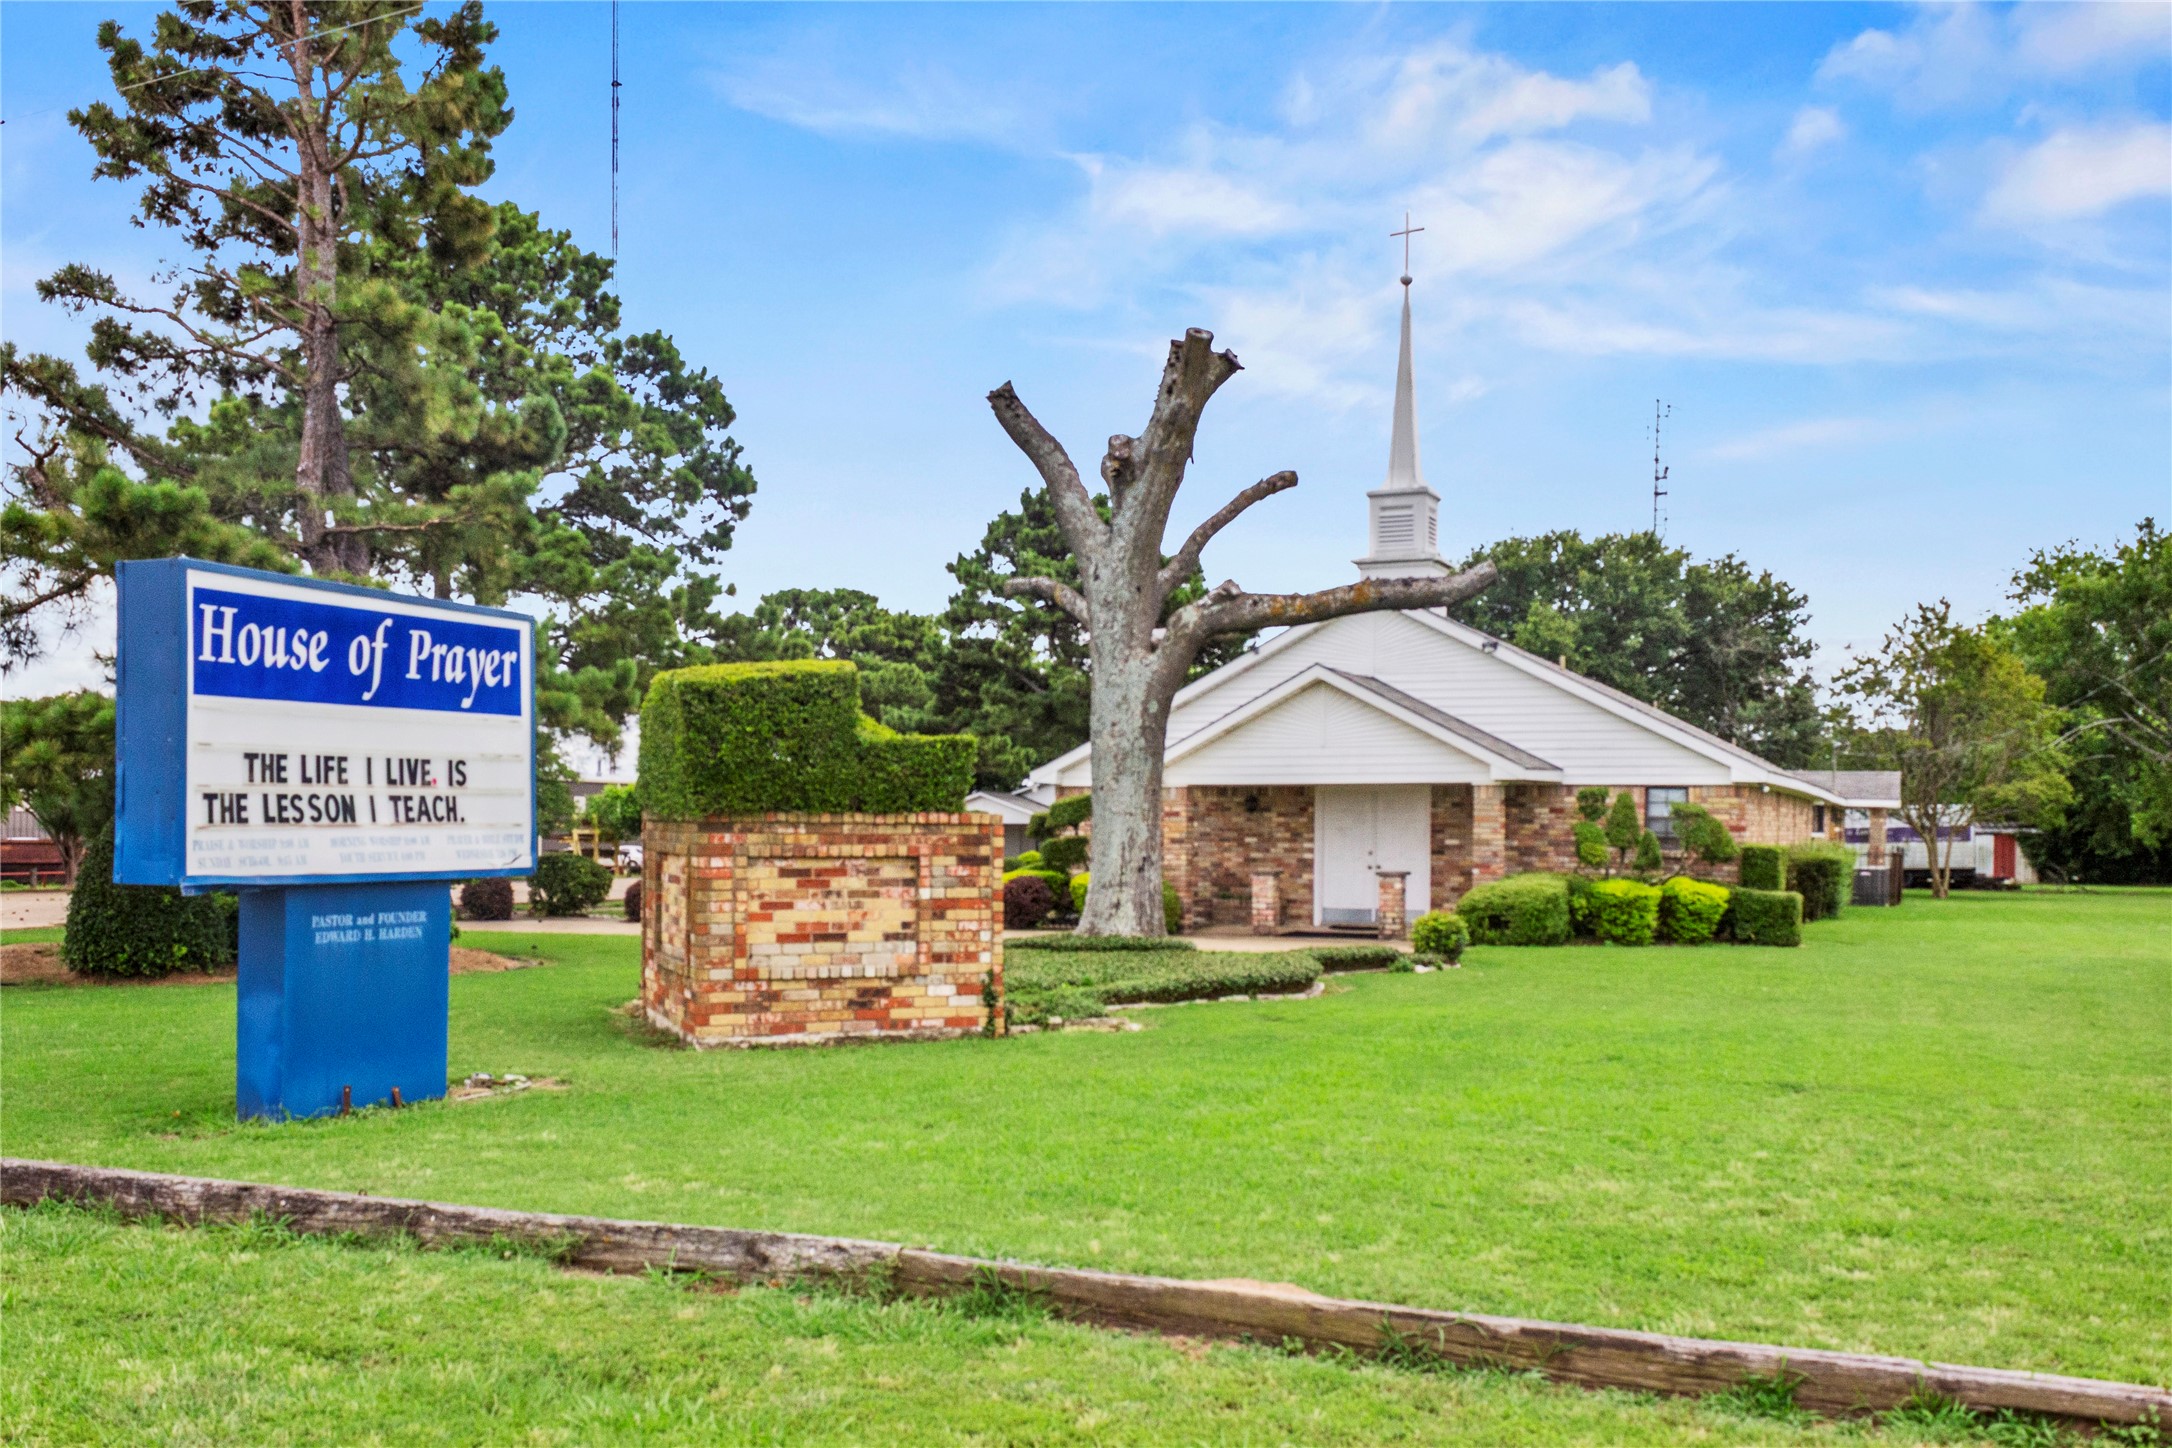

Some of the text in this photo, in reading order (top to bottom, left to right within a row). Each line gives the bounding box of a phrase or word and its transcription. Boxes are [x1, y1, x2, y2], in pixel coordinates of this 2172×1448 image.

[198, 603, 518, 709] House of Prayer
[243, 752, 288, 784] THE
[301, 754, 348, 785] LIFE
[366, 757, 373, 785] I
[448, 759, 467, 787] IS
[202, 793, 465, 824] THE LESSON I TEACH.
[312, 911, 427, 928] PASTOR and FOUNDER
[315, 930, 361, 944] EDWARD
